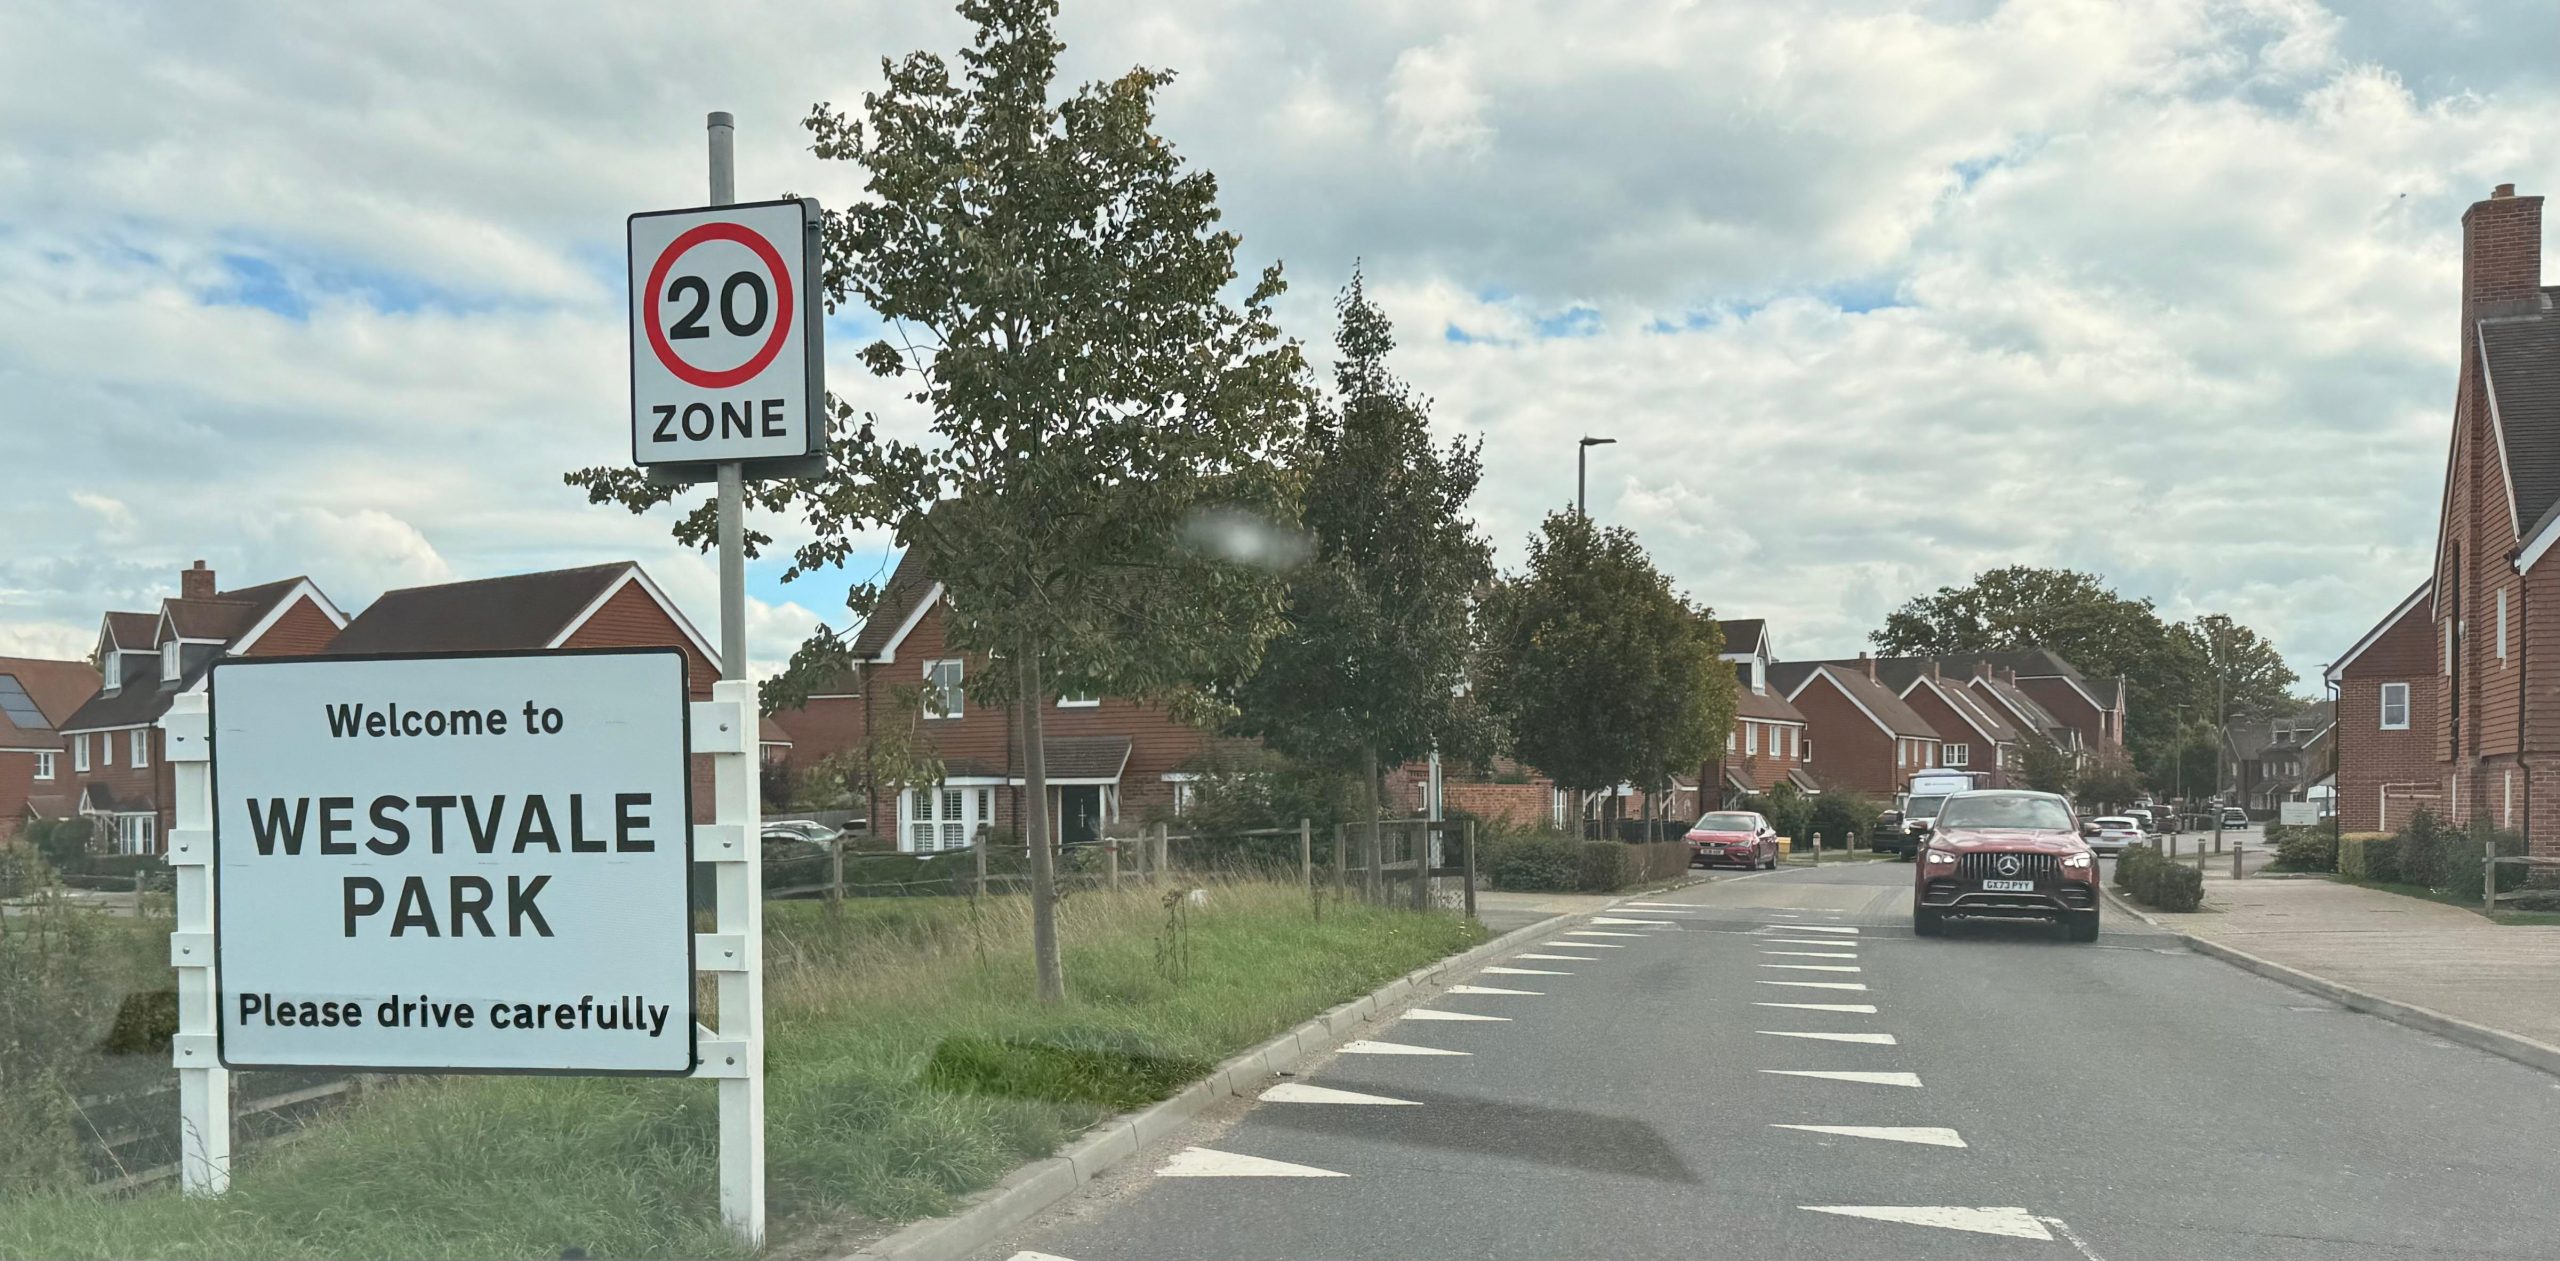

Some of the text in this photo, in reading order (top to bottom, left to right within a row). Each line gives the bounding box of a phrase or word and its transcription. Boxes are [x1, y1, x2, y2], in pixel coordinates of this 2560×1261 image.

[667, 271, 769, 341] 20
[652, 398, 787, 443] ZONE
[325, 699, 564, 738] Welcome to
[246, 792, 656, 856] WESTVALE
[343, 875, 555, 938] PARK
[1986, 880, 2011, 890] GX73
[239, 992, 670, 1038] Please drive carefully
